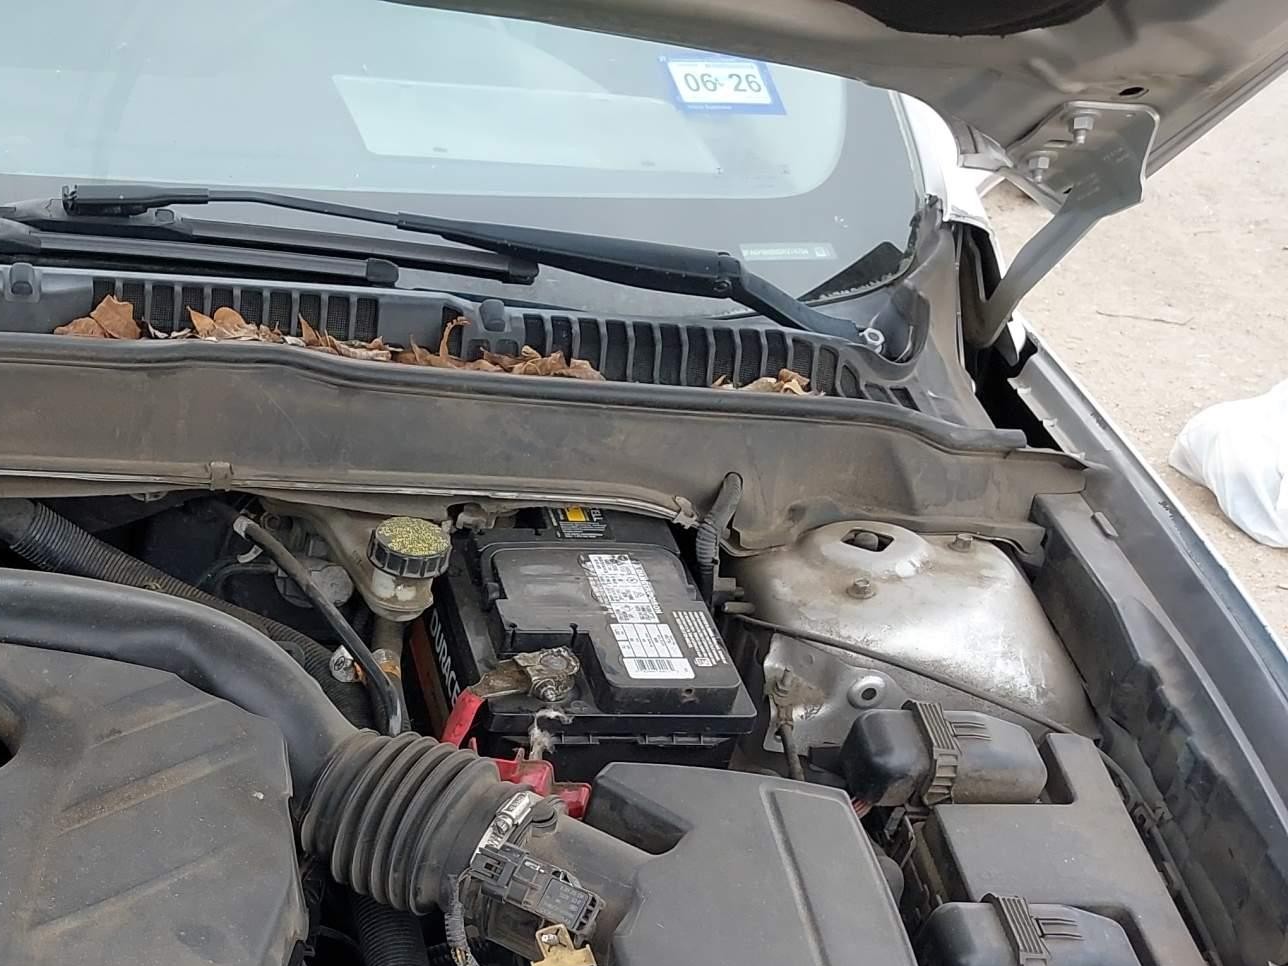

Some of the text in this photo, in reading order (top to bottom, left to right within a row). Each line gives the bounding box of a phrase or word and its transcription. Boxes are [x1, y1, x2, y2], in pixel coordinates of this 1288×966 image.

[683, 72, 762, 93] 06 26
[430, 608, 461, 710] DURACE
